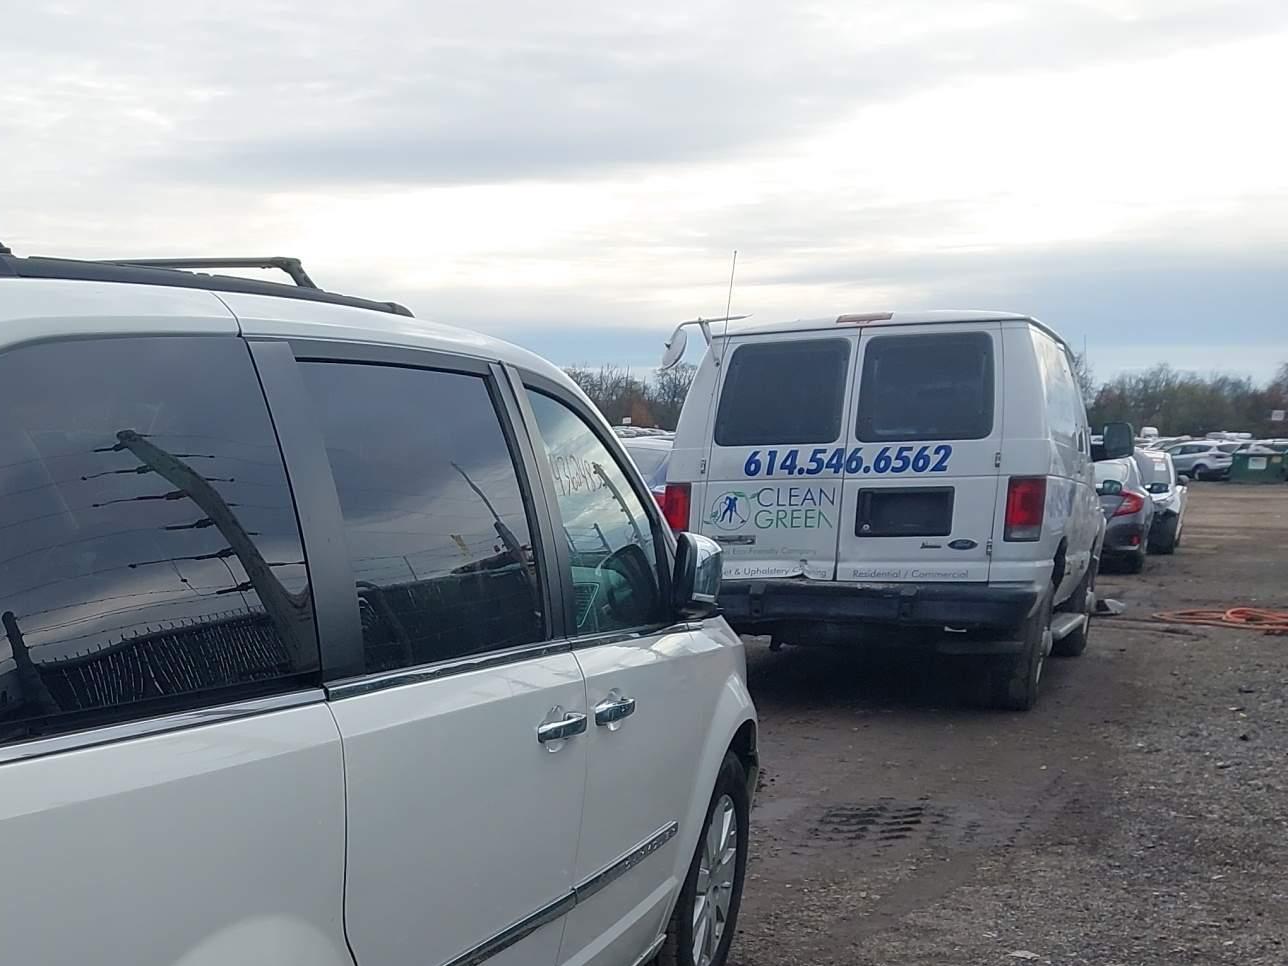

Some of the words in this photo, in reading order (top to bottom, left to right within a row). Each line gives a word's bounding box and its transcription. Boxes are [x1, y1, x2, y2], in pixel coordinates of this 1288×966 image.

[744, 445, 953, 477] 614.546.6562
[756, 487, 836, 507] CLEAN
[754, 508, 832, 529] GREEN
[734, 567, 741, 575] &
[744, 567, 789, 576] Upholstery
[852, 569, 901, 577] Residential
[912, 569, 968, 577] Commercial
